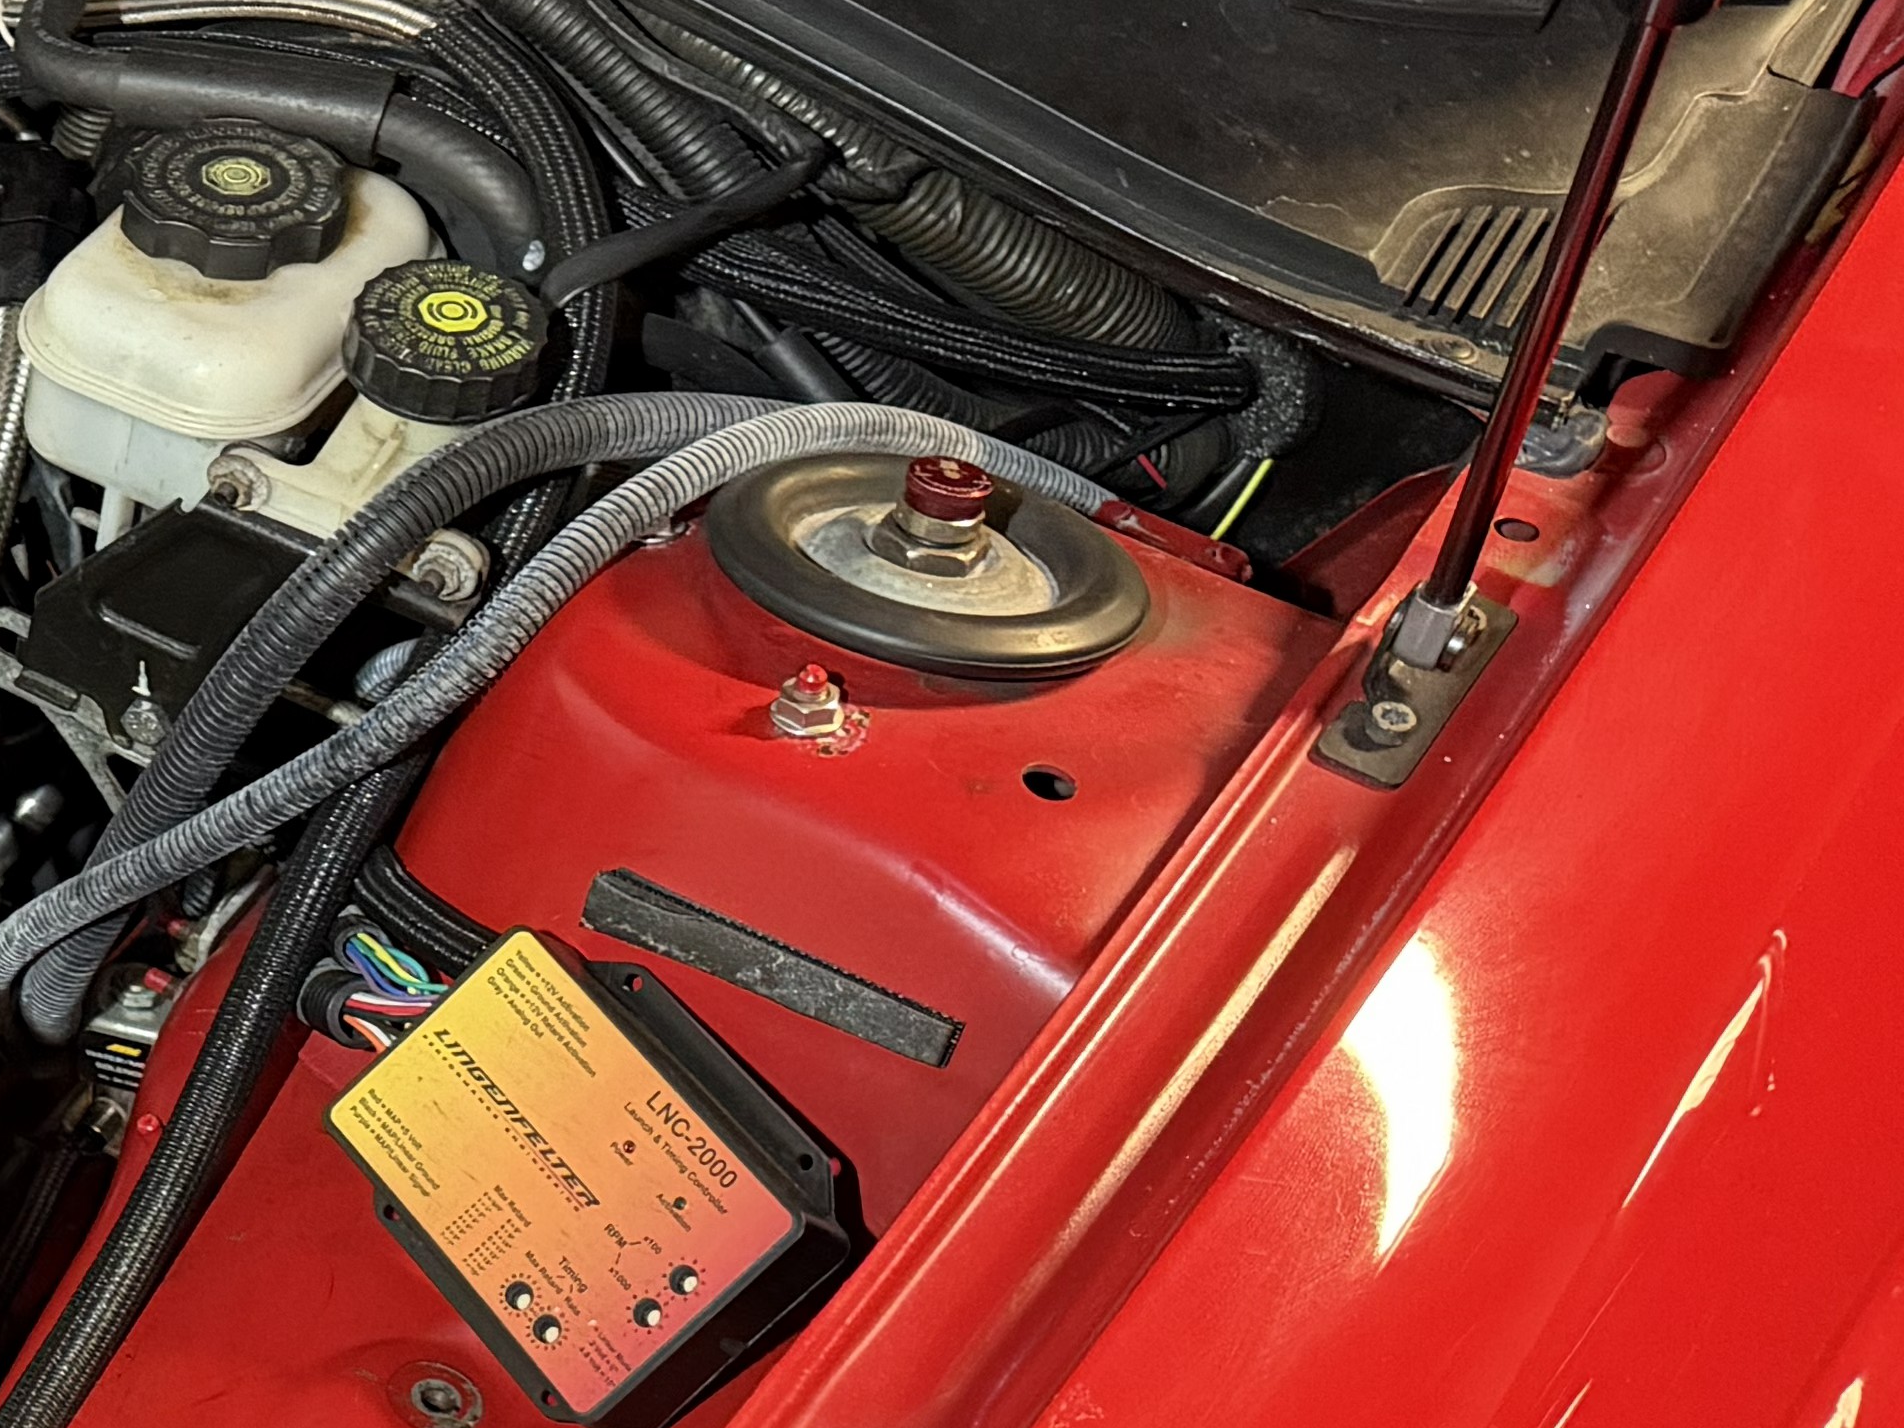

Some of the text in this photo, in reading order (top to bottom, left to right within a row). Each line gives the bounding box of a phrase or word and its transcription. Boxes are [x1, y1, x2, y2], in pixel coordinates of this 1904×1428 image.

[419, 341, 458, 360] FLUID
[484, 975, 544, 1038] Gray Analog Out
[493, 966, 522, 996] Orange
[540, 1015, 565, 1042] Retard
[561, 1039, 598, 1078] Activation
[504, 957, 589, 1048] Green Ground Activation
[555, 994, 592, 1032] Activation
[348, 1105, 371, 1130] Purple
[366, 1088, 382, 1104] Red
[384, 1107, 401, 1126] MAP
[407, 1133, 423, 1150] Volt
[430, 1023, 603, 1211] LINGENFELTER
[609, 1141, 634, 1167] Power
[622, 1101, 656, 1136] Launch
[657, 1140, 690, 1175] Timing
[685, 1170, 730, 1216] Controller
[643, 1089, 741, 1190] LNC-2000
[413, 1160, 441, 1191] Ground
[505, 1200, 532, 1228] Retard
[655, 1192, 693, 1232] Activation
[603, 1222, 628, 1249] RPM
[553, 1255, 591, 1294] Timing
